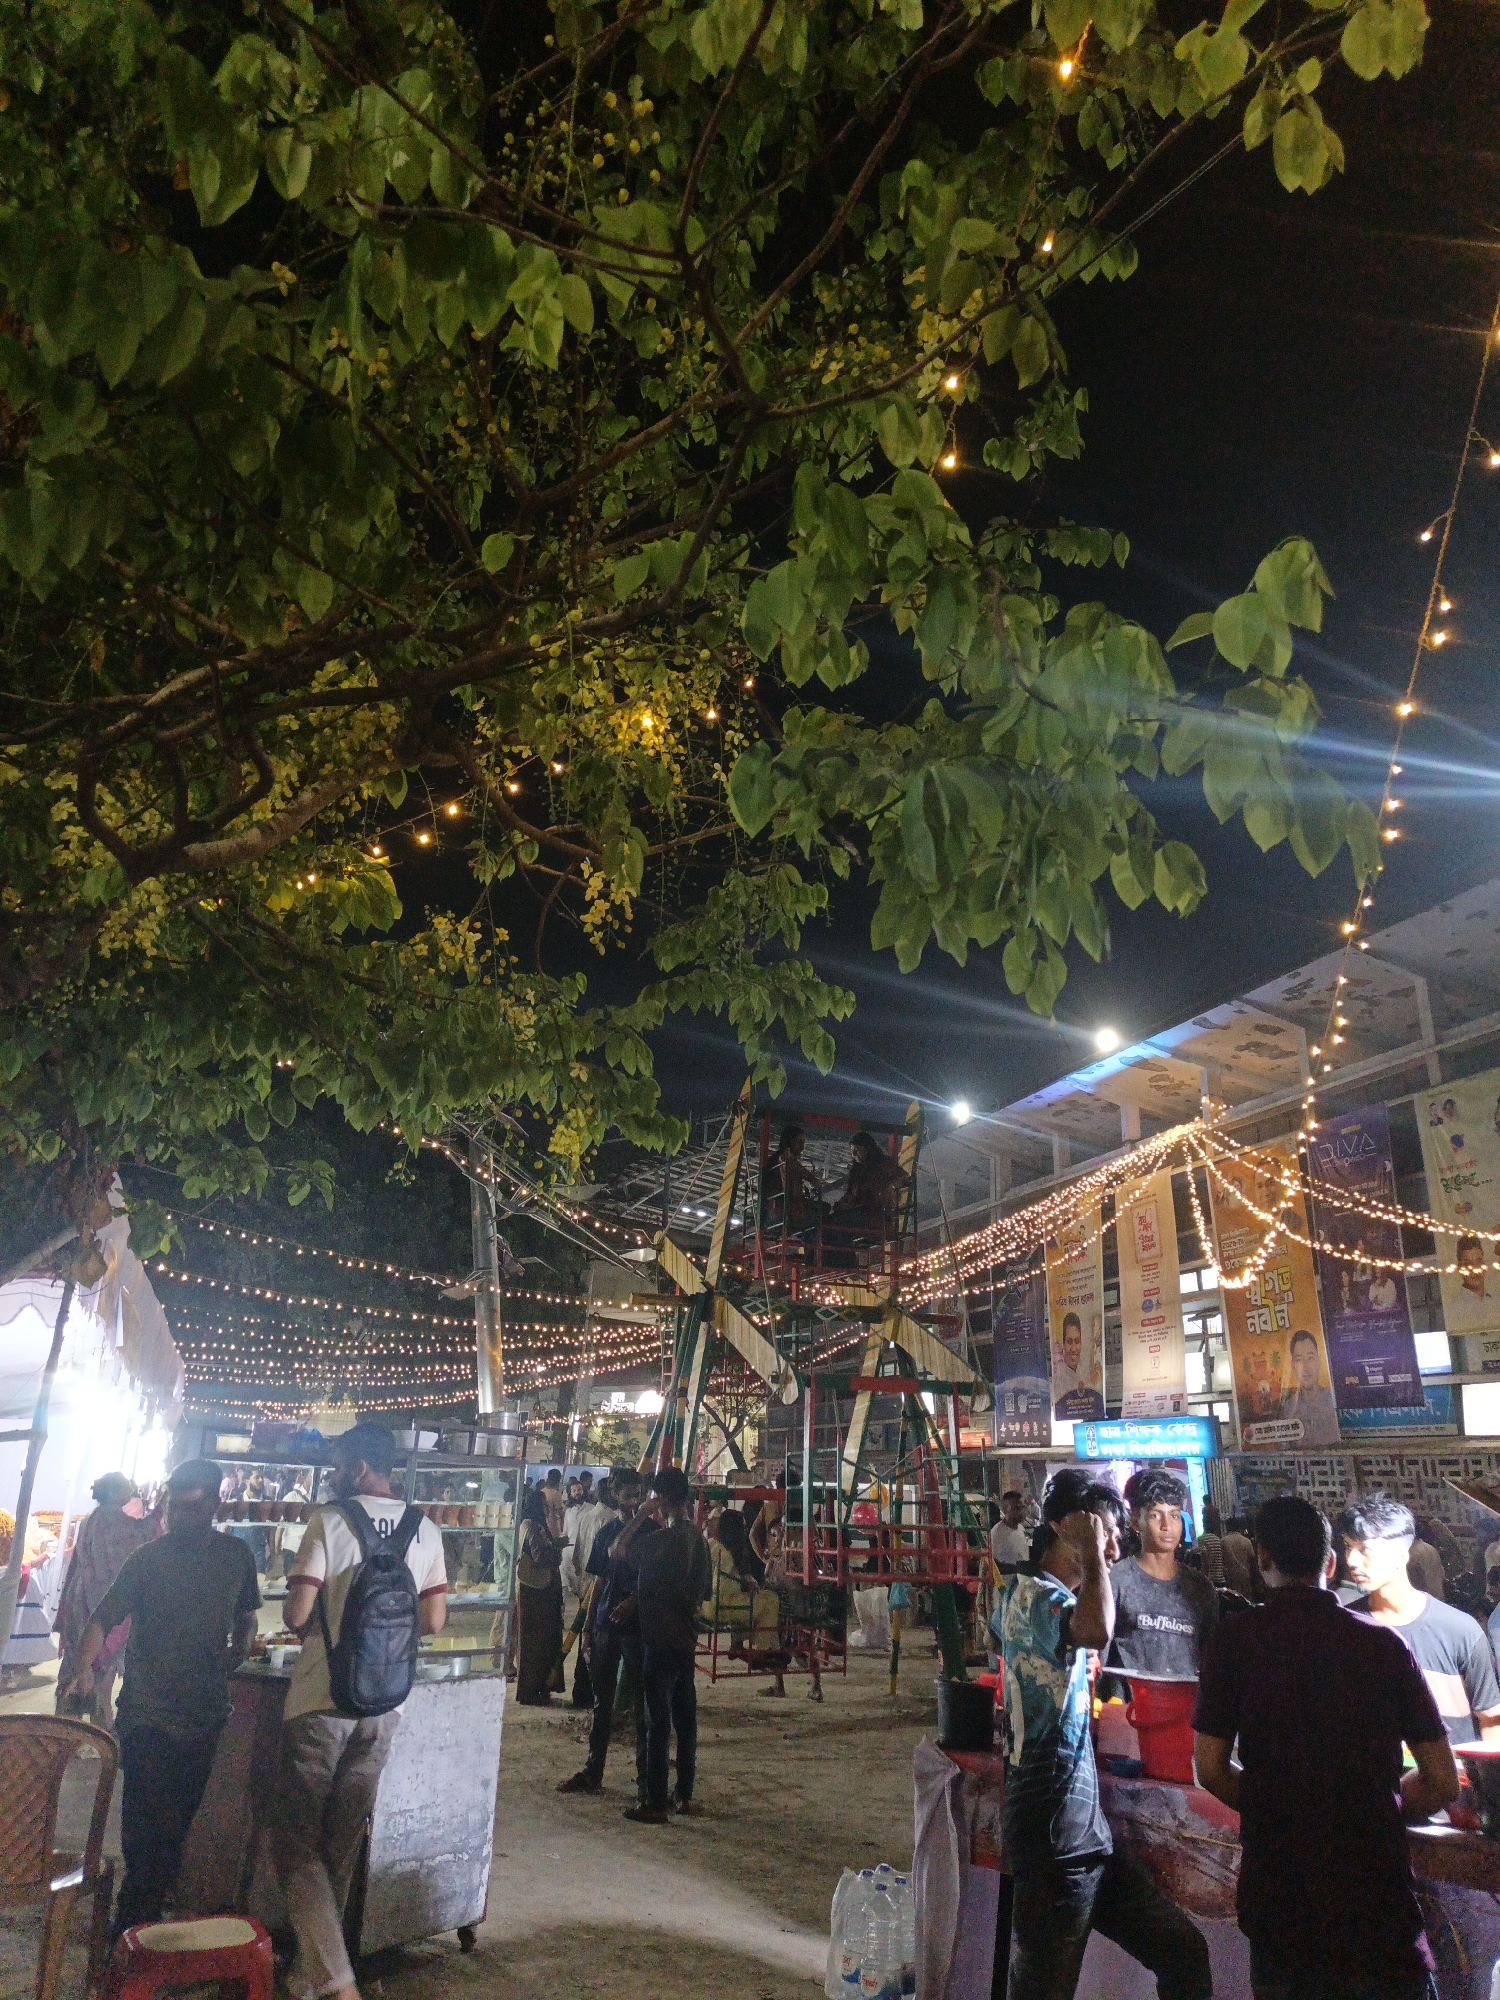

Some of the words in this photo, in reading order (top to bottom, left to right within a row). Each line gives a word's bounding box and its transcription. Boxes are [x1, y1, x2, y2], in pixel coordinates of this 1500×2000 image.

[1245, 1266, 1292, 1306] স্বাগত
[1246, 1298, 1291, 1335] নবীন
[1166, 1421, 1197, 1437] কেন্দ্র
[1100, 1443, 1125, 1456] ঢাকা
[1139, 1614, 1194, 1634] Buffaloes
